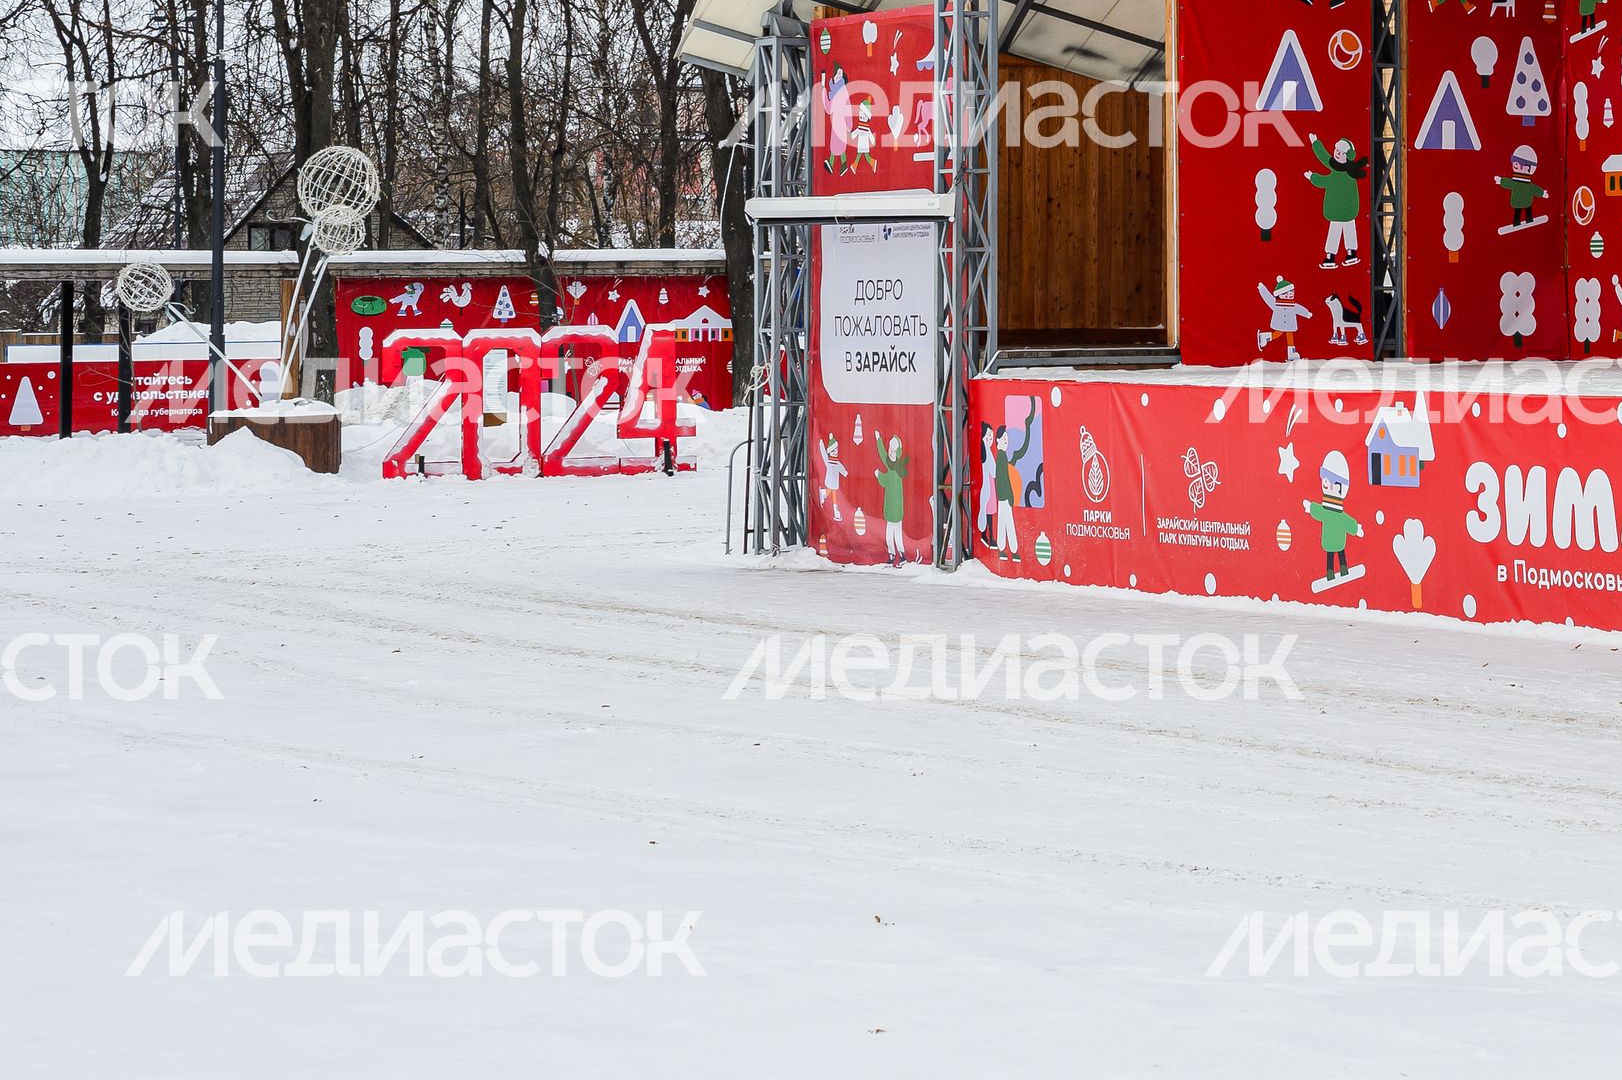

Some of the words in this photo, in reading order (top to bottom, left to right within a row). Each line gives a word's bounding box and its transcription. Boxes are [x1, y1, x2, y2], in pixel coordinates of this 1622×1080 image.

[854, 279, 904, 306] ДОБРО
[834, 315, 928, 337] ПОЖАЛОВАТЬ
[845, 351, 853, 372] В
[855, 344, 917, 373] ЗАРАЙСК
[93, 393, 103, 402] с
[382, 323, 697, 480] 2024
[151, 406, 203, 418] губернатора
[1083, 509, 1112, 524] ПАРКИ
[1156, 516, 1199, 532] ЗАРАЙСКИЙ
[1200, 520, 1251, 537] ЦЕНТРАЛЬНЫЙ
[1065, 523, 1131, 541] ПОДМОСКОВЬЯ
[1159, 531, 1177, 544] ПАРК
[1178, 534, 1212, 548] КУЛЬТУРЫ
[1213, 537, 1219, 548] И
[1220, 538, 1250, 551] ОТДЫХА
[1497, 565, 1508, 583] в
